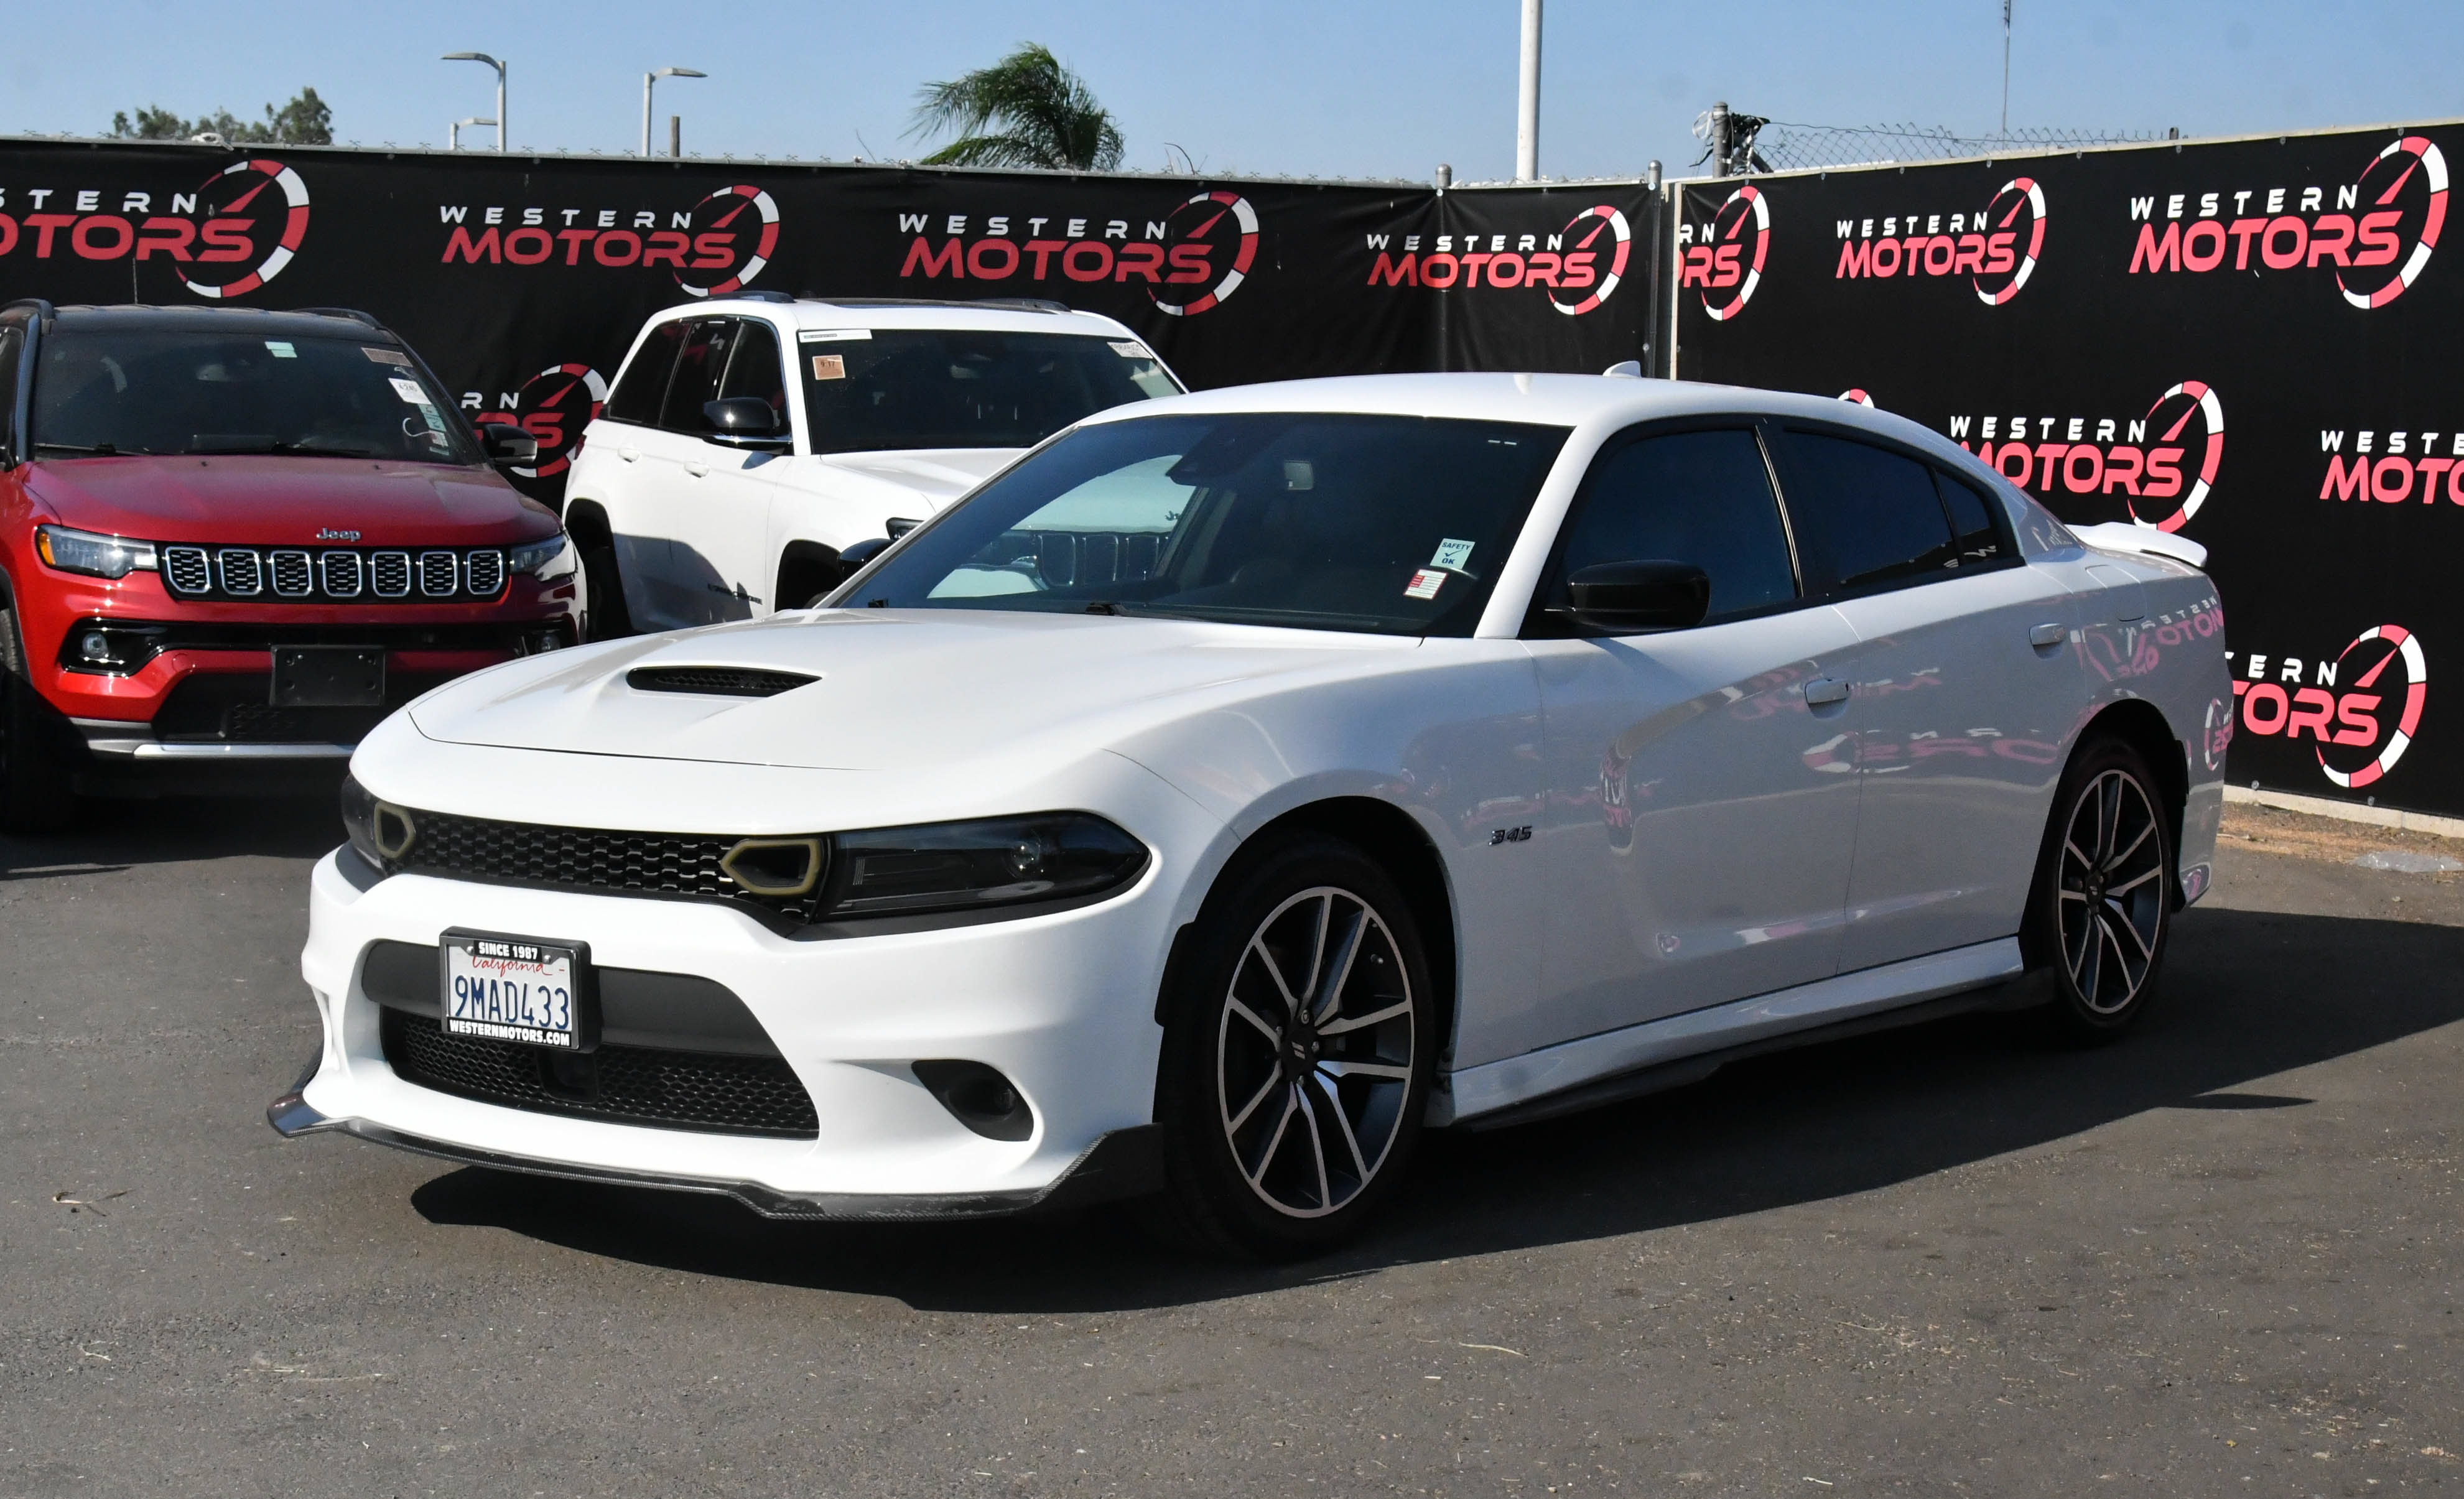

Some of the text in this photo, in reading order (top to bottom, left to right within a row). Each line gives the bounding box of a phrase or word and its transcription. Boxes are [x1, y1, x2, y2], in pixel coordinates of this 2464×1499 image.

[0, 188, 196, 213] TERN
[2131, 185, 2358, 221] WESTERN
[440, 207, 690, 228] WESTERN
[900, 214, 1165, 239] WESTERN
[1837, 211, 1987, 238] WESTERN
[443, 226, 735, 268] MOTORS
[1367, 234, 1562, 251] WESTERN
[1836, 232, 2017, 279] MOTORS
[2129, 211, 2403, 274] MOTORS
[901, 237, 1212, 283] MOTORS
[1368, 252, 1597, 289] MOTORS
[1951, 416, 2146, 443] WESTERN
[316, 527, 361, 542] Jeep
[1442, 542, 1471, 550] SAFETY
[1488, 826, 1533, 845] 345
[478, 942, 538, 960] SINCE 1987
[472, 955, 552, 977] California
[455, 975, 569, 1029] 9MAD433
[450, 1019, 570, 1046] WESTERNMOTORS.COM
